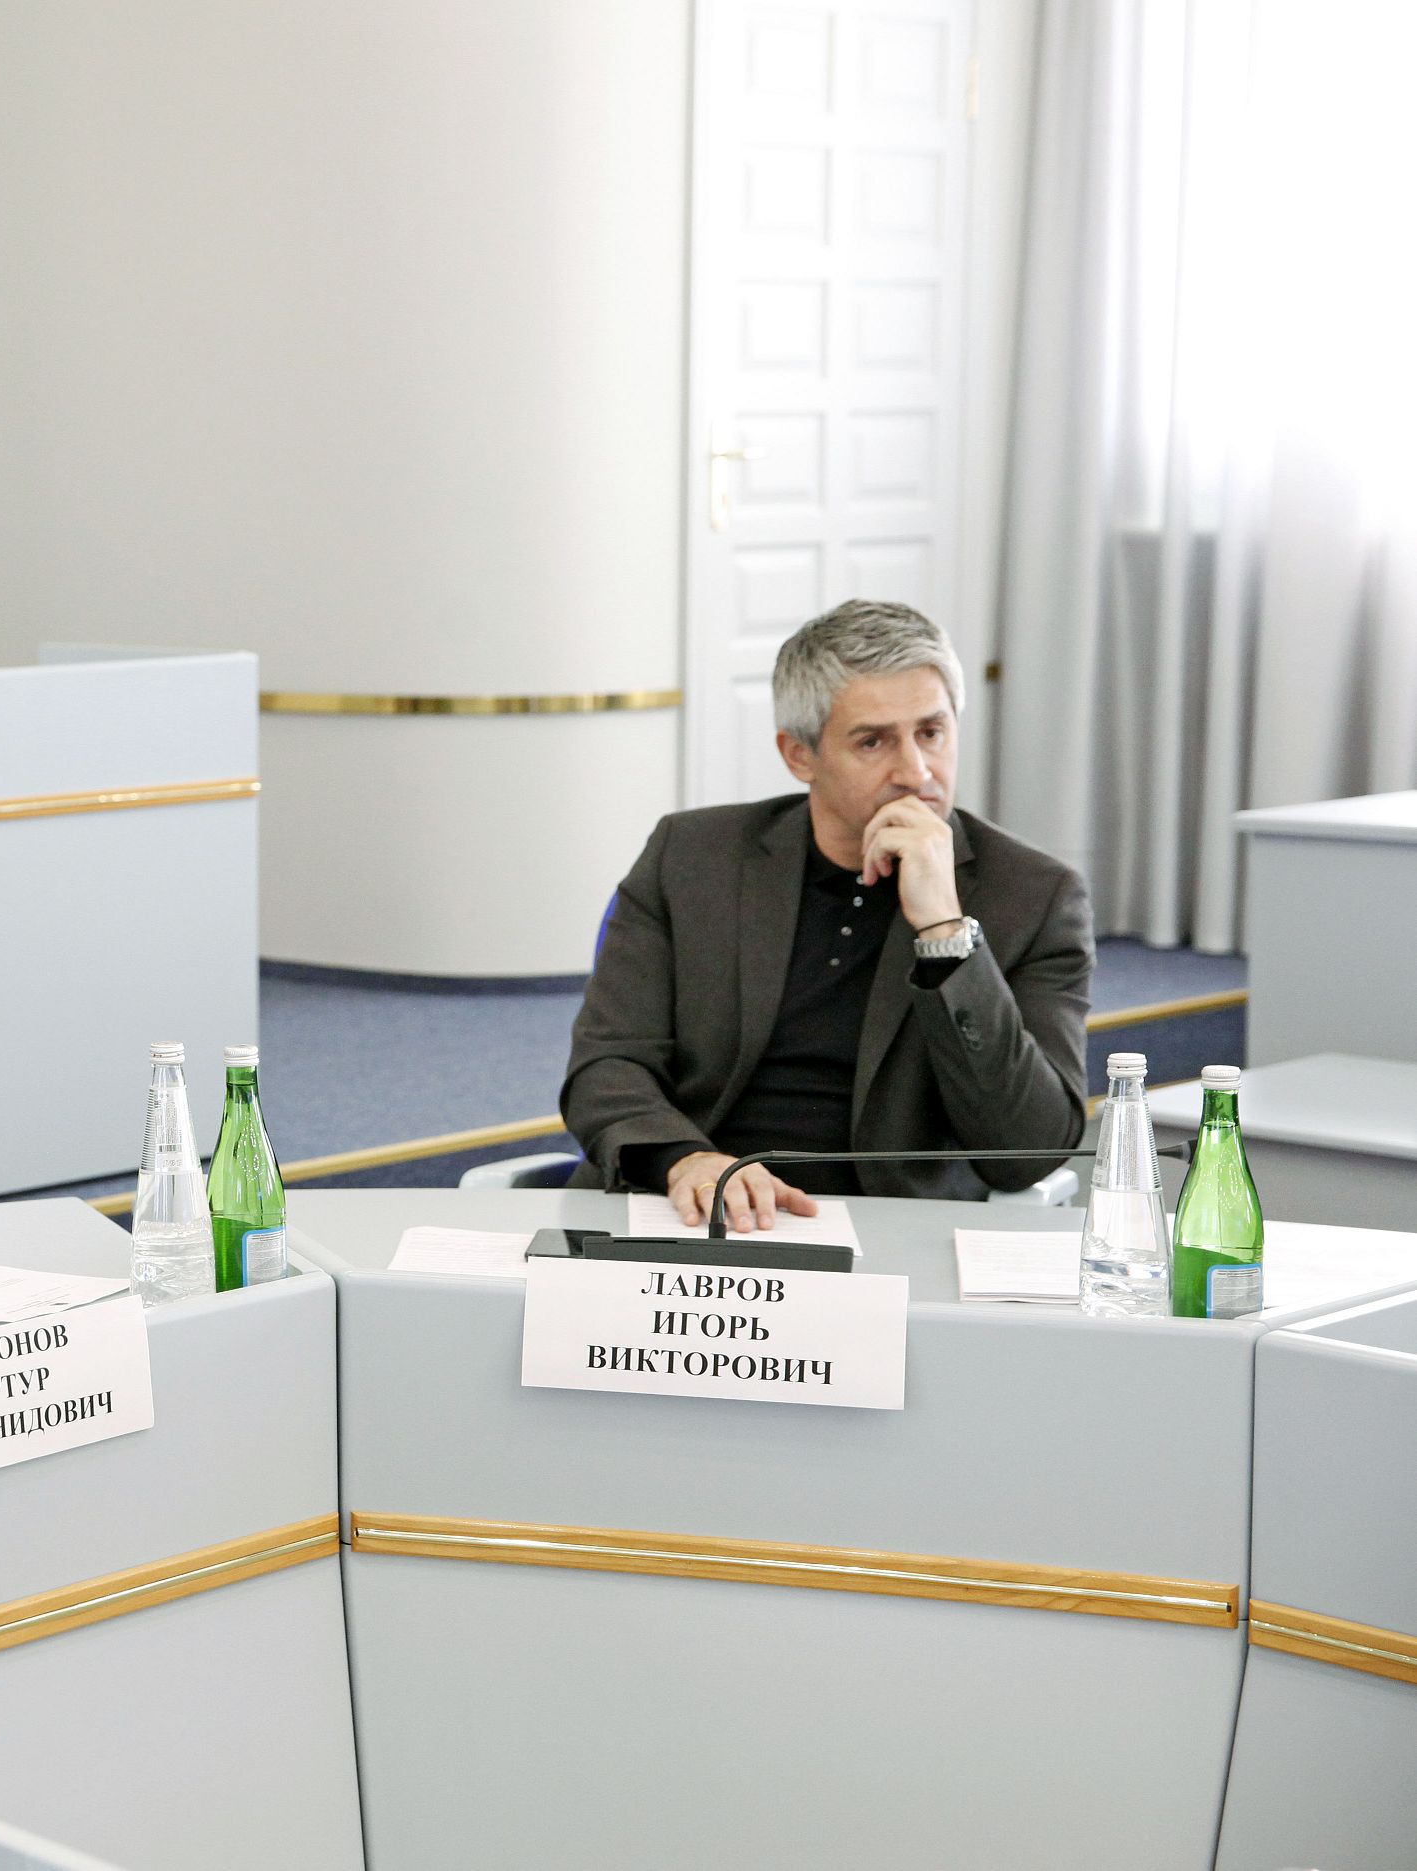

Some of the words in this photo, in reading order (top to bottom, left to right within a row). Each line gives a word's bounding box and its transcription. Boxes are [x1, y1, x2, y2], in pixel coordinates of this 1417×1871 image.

[641, 1272, 785, 1303] ЛАВРОВ
[651, 1310, 770, 1341] ИГОРЬ
[586, 1344, 833, 1385] ВИКТОРОВИЧ
